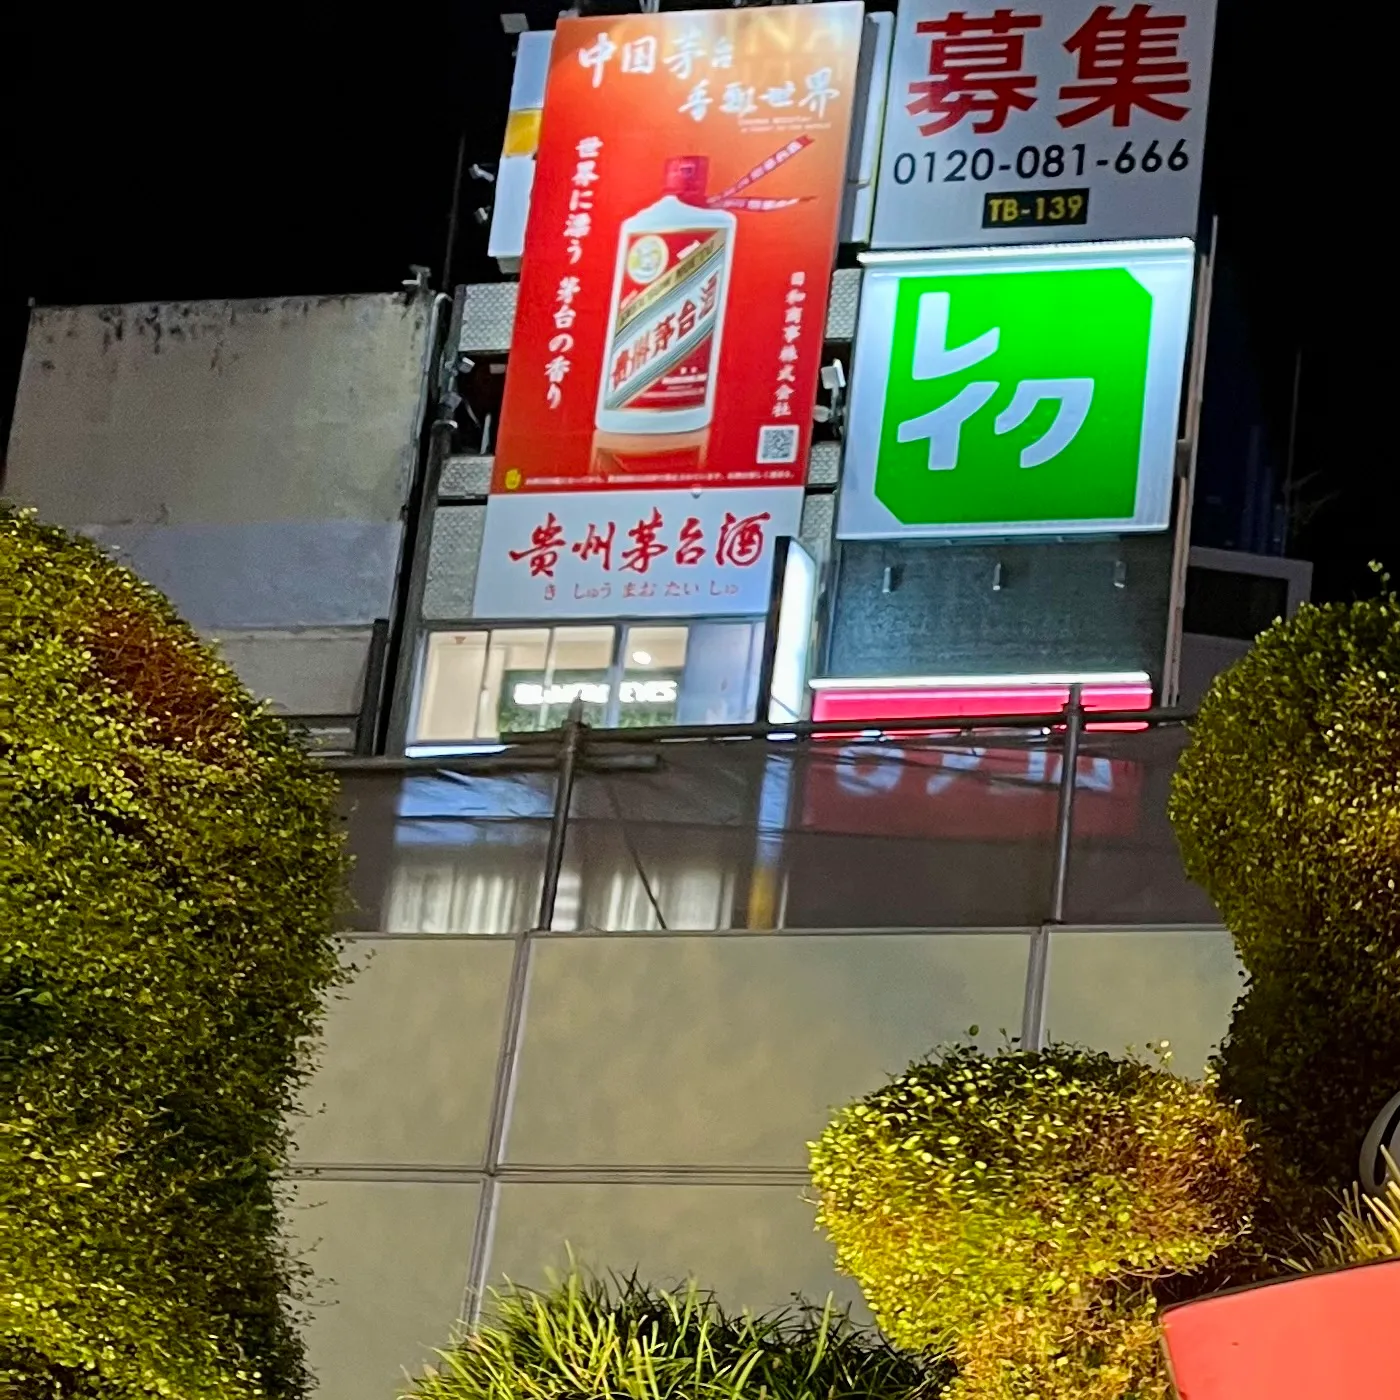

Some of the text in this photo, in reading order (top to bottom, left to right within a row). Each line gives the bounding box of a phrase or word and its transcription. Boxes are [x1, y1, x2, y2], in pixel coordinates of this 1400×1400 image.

[904, 3, 1193, 137] 募集
[892, 138, 1190, 186] 0120-081-666
[988, 193, 1084, 223] TB-139
[911, 291, 1001, 380] レ
[896, 377, 1095, 471] イク
